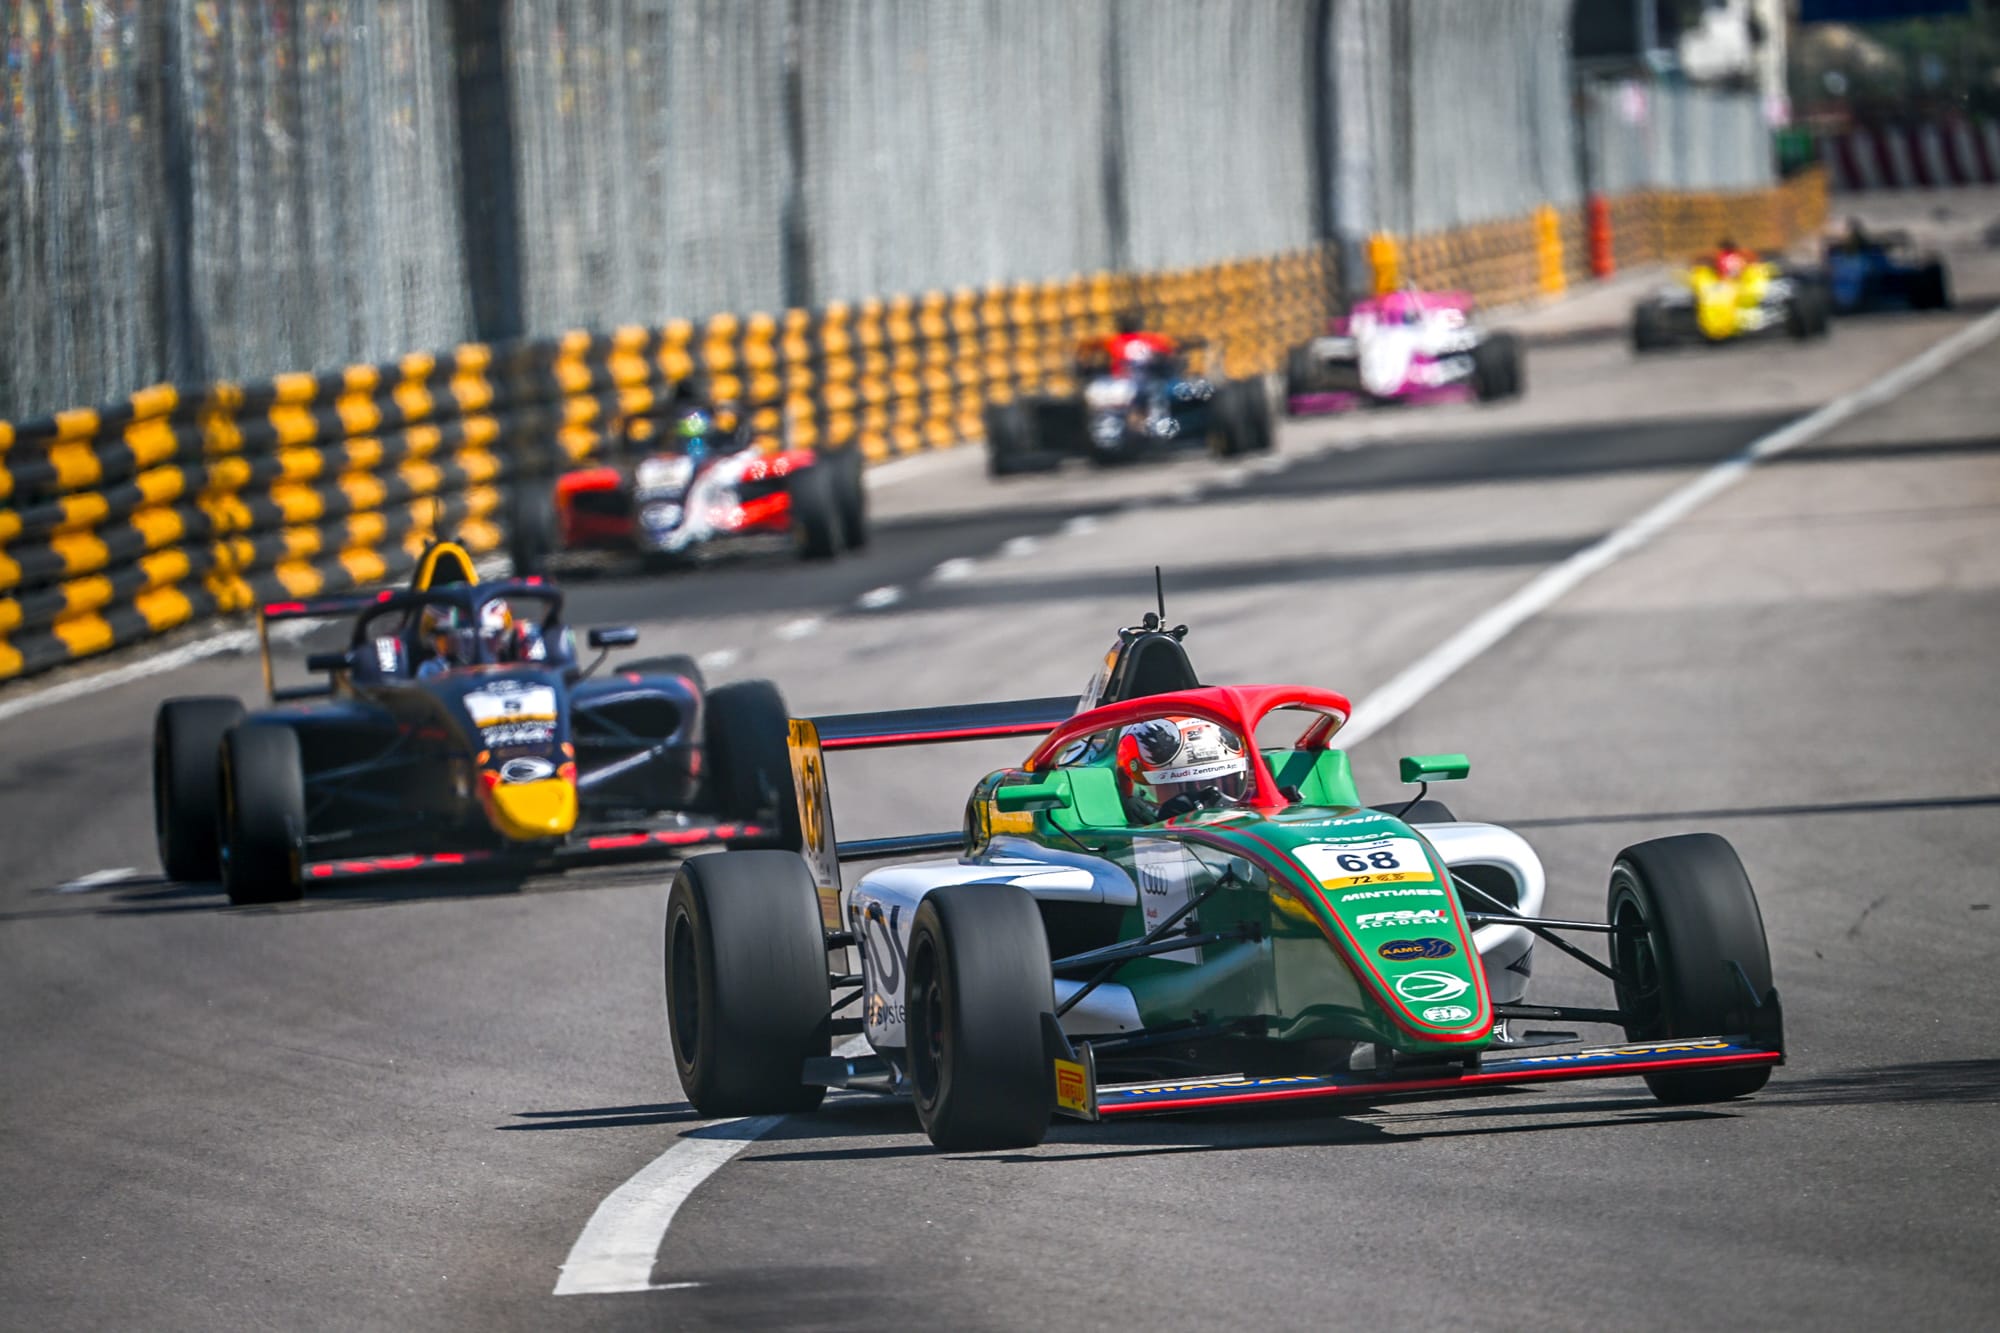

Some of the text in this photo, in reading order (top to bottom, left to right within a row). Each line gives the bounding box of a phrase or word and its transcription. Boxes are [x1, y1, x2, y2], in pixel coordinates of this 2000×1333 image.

[1170, 771, 1191, 779] Audi
[1193, 765, 1225, 776] Zentrum
[1336, 851, 1401, 872] 68
[1349, 875, 1373, 885] 72
[1356, 910, 1437, 924] FFSA
[1360, 917, 1449, 929] ACADEMY
[1382, 946, 1424, 955] AAMC
[877, 999, 906, 1031] syste
